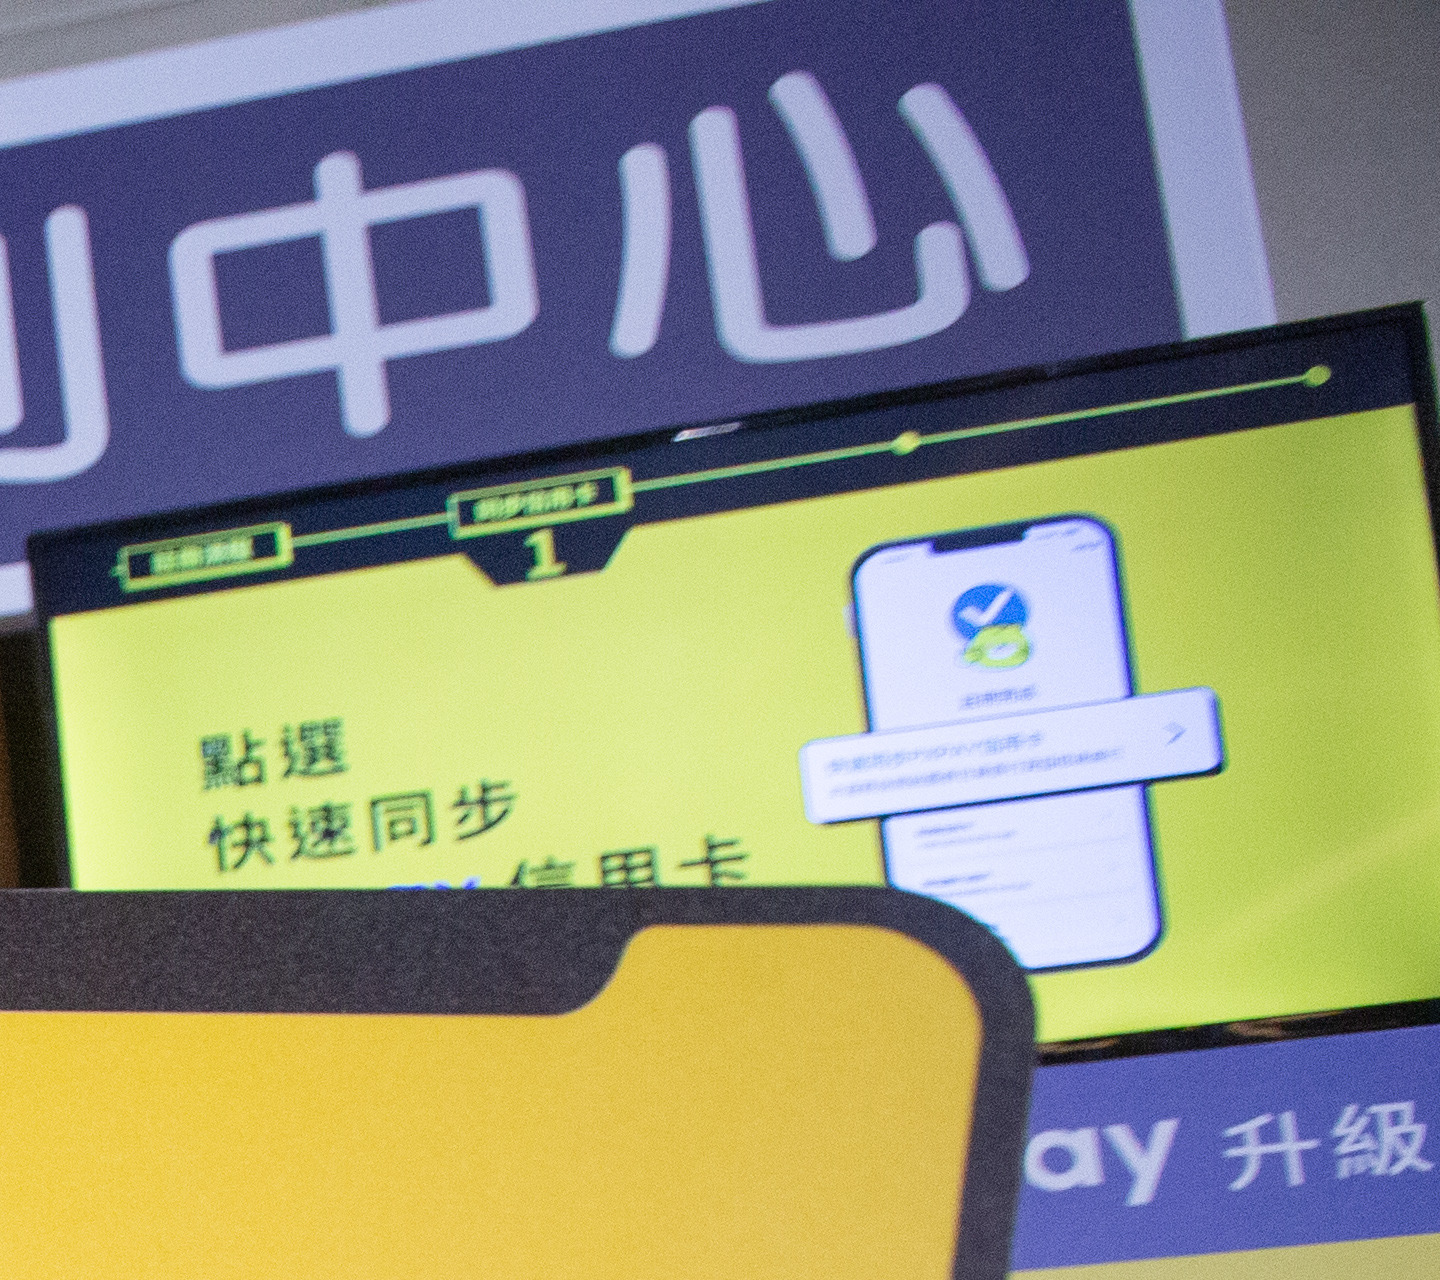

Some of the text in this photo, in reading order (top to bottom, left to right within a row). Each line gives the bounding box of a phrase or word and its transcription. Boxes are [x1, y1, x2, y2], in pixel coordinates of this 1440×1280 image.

[524, 528, 567, 582] 1
[199, 716, 350, 792] 點選
[207, 777, 518, 873] 快速同步
[1221, 1099, 1436, 1192] 升級
